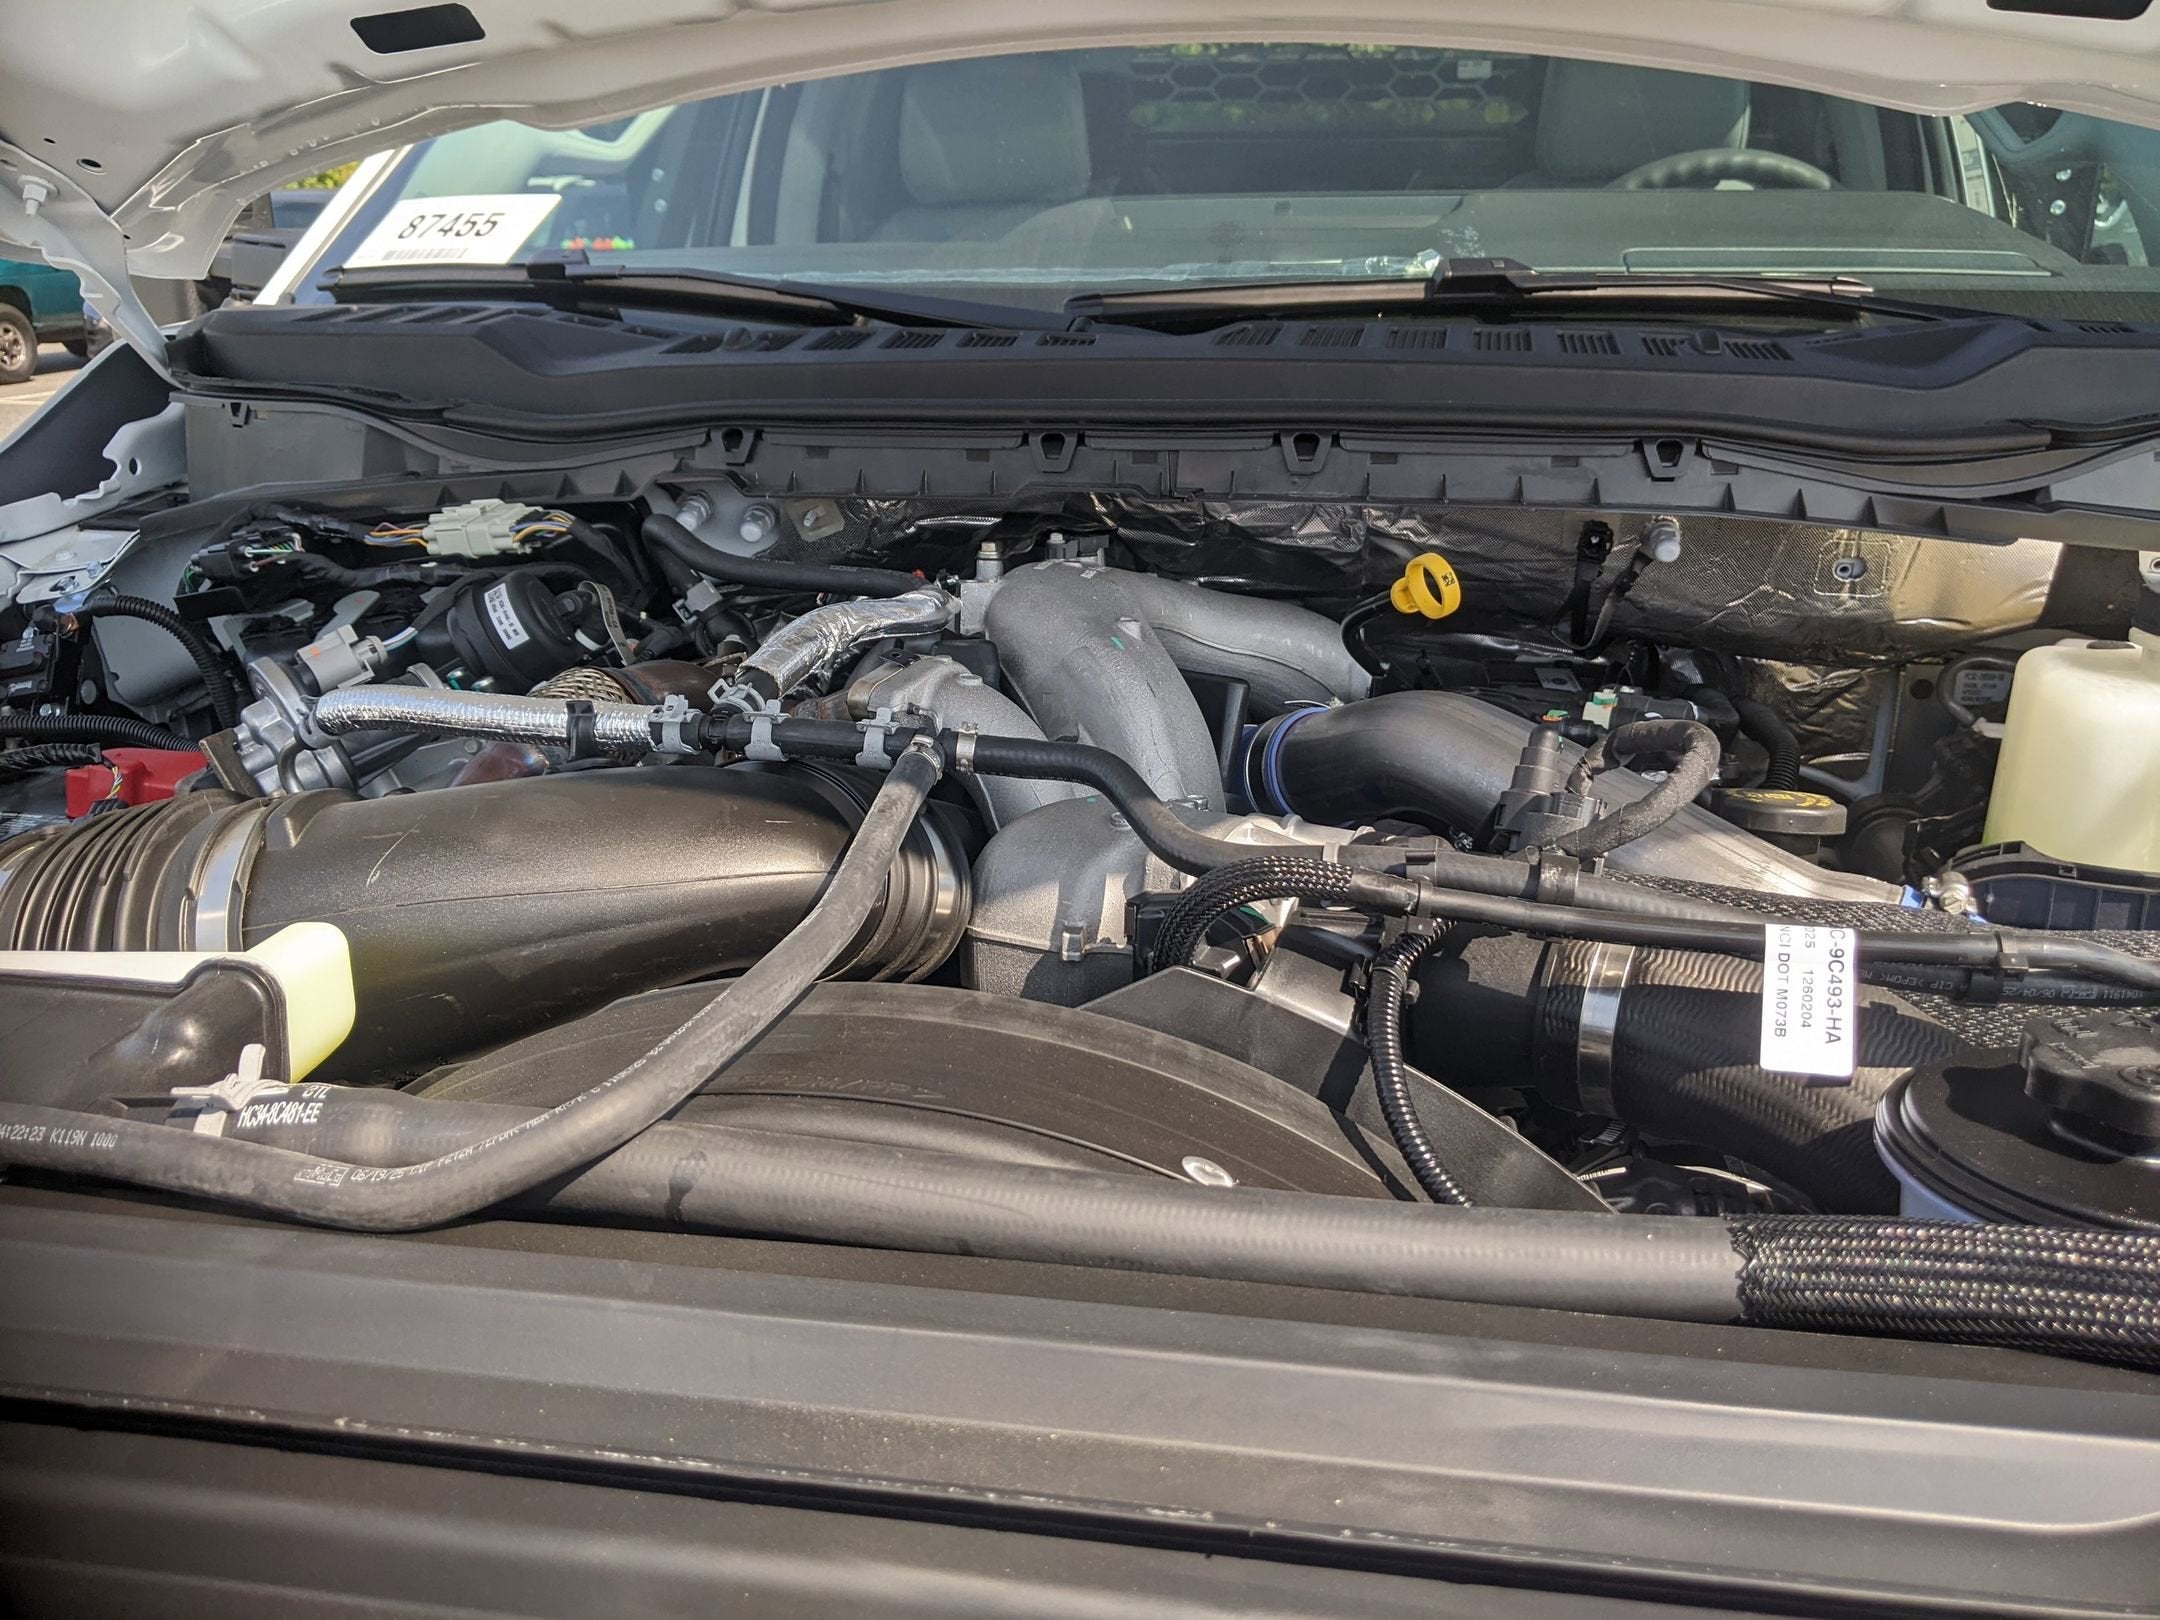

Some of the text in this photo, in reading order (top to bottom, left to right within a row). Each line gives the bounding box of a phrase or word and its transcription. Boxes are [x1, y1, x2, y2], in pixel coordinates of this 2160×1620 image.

[398, 213, 505, 239] 87455
[1777, 952, 1791, 984] DOT
[1774, 988, 1789, 1037] M073B
[1800, 970, 1815, 1029] 1260204
